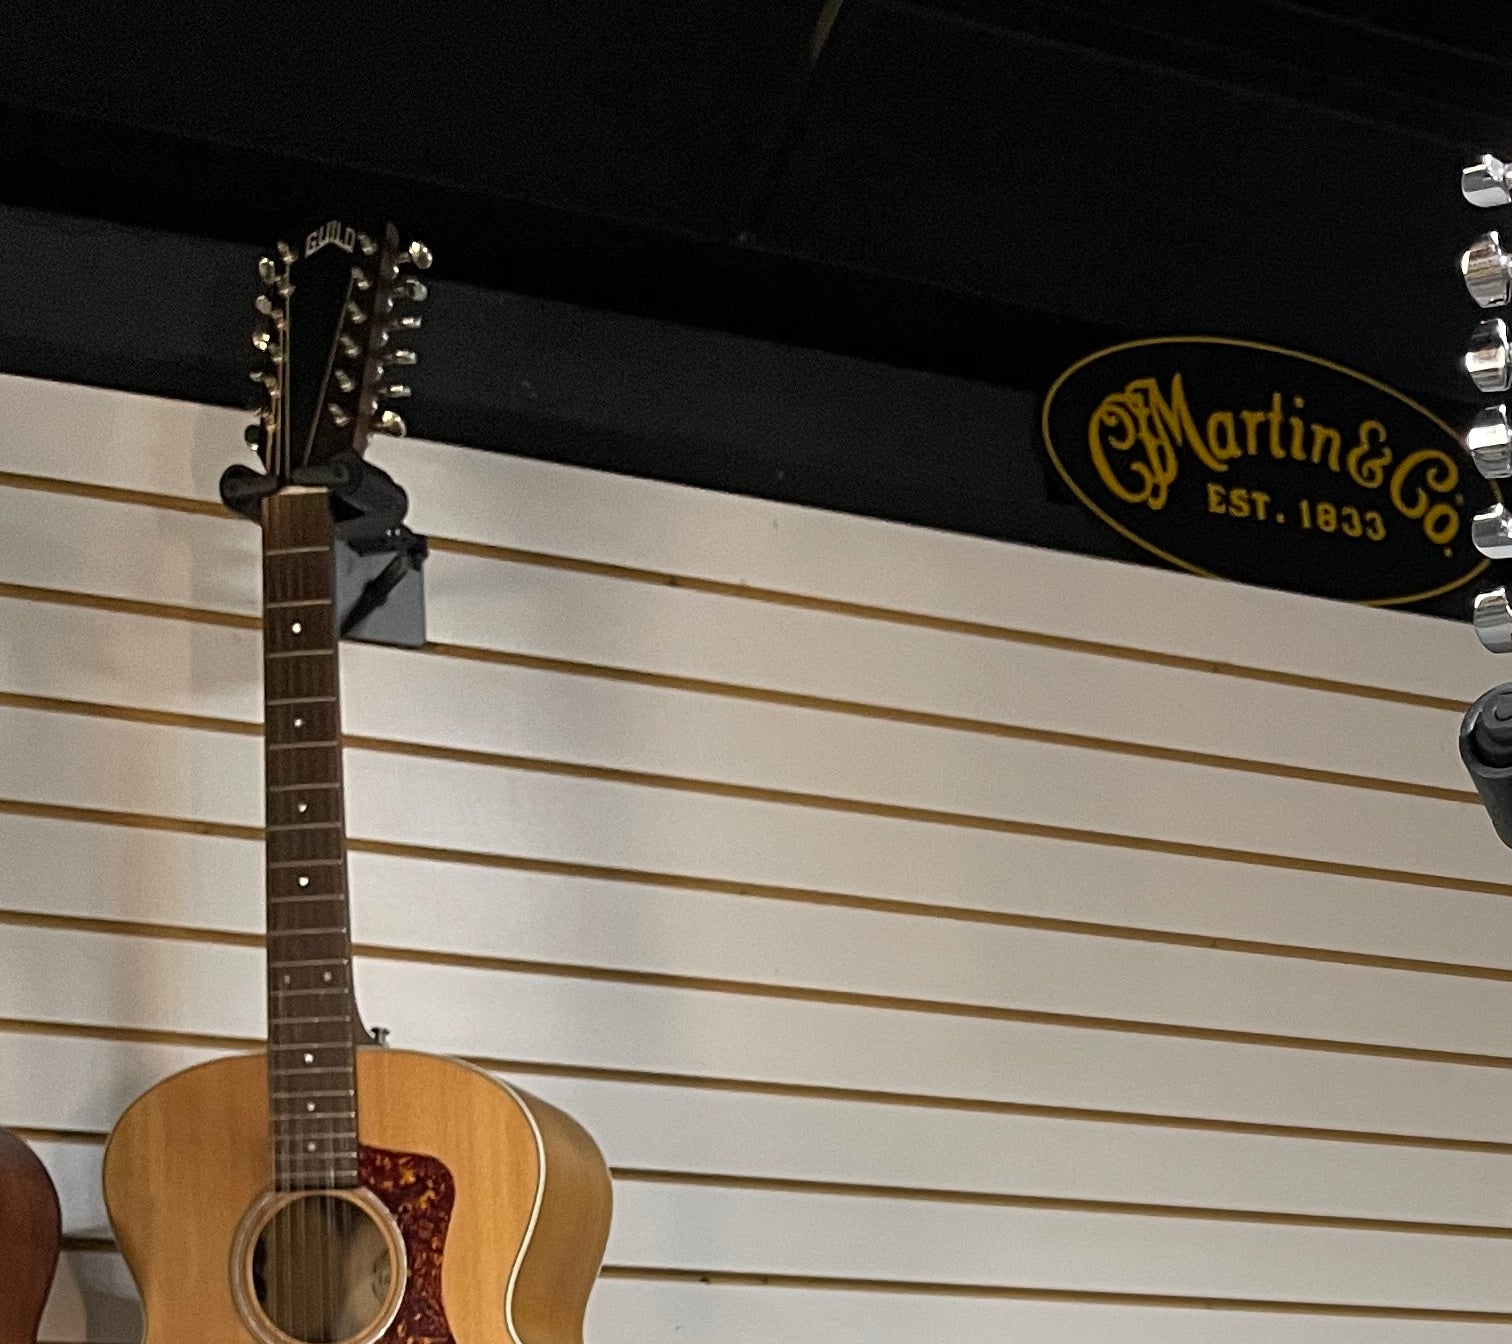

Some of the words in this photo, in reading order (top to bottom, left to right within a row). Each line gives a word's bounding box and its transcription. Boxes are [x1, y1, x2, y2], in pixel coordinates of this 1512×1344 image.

[304, 219, 356, 258] GUILD
[1207, 483, 1285, 523] EST.
[1300, 500, 1387, 541] 1833
